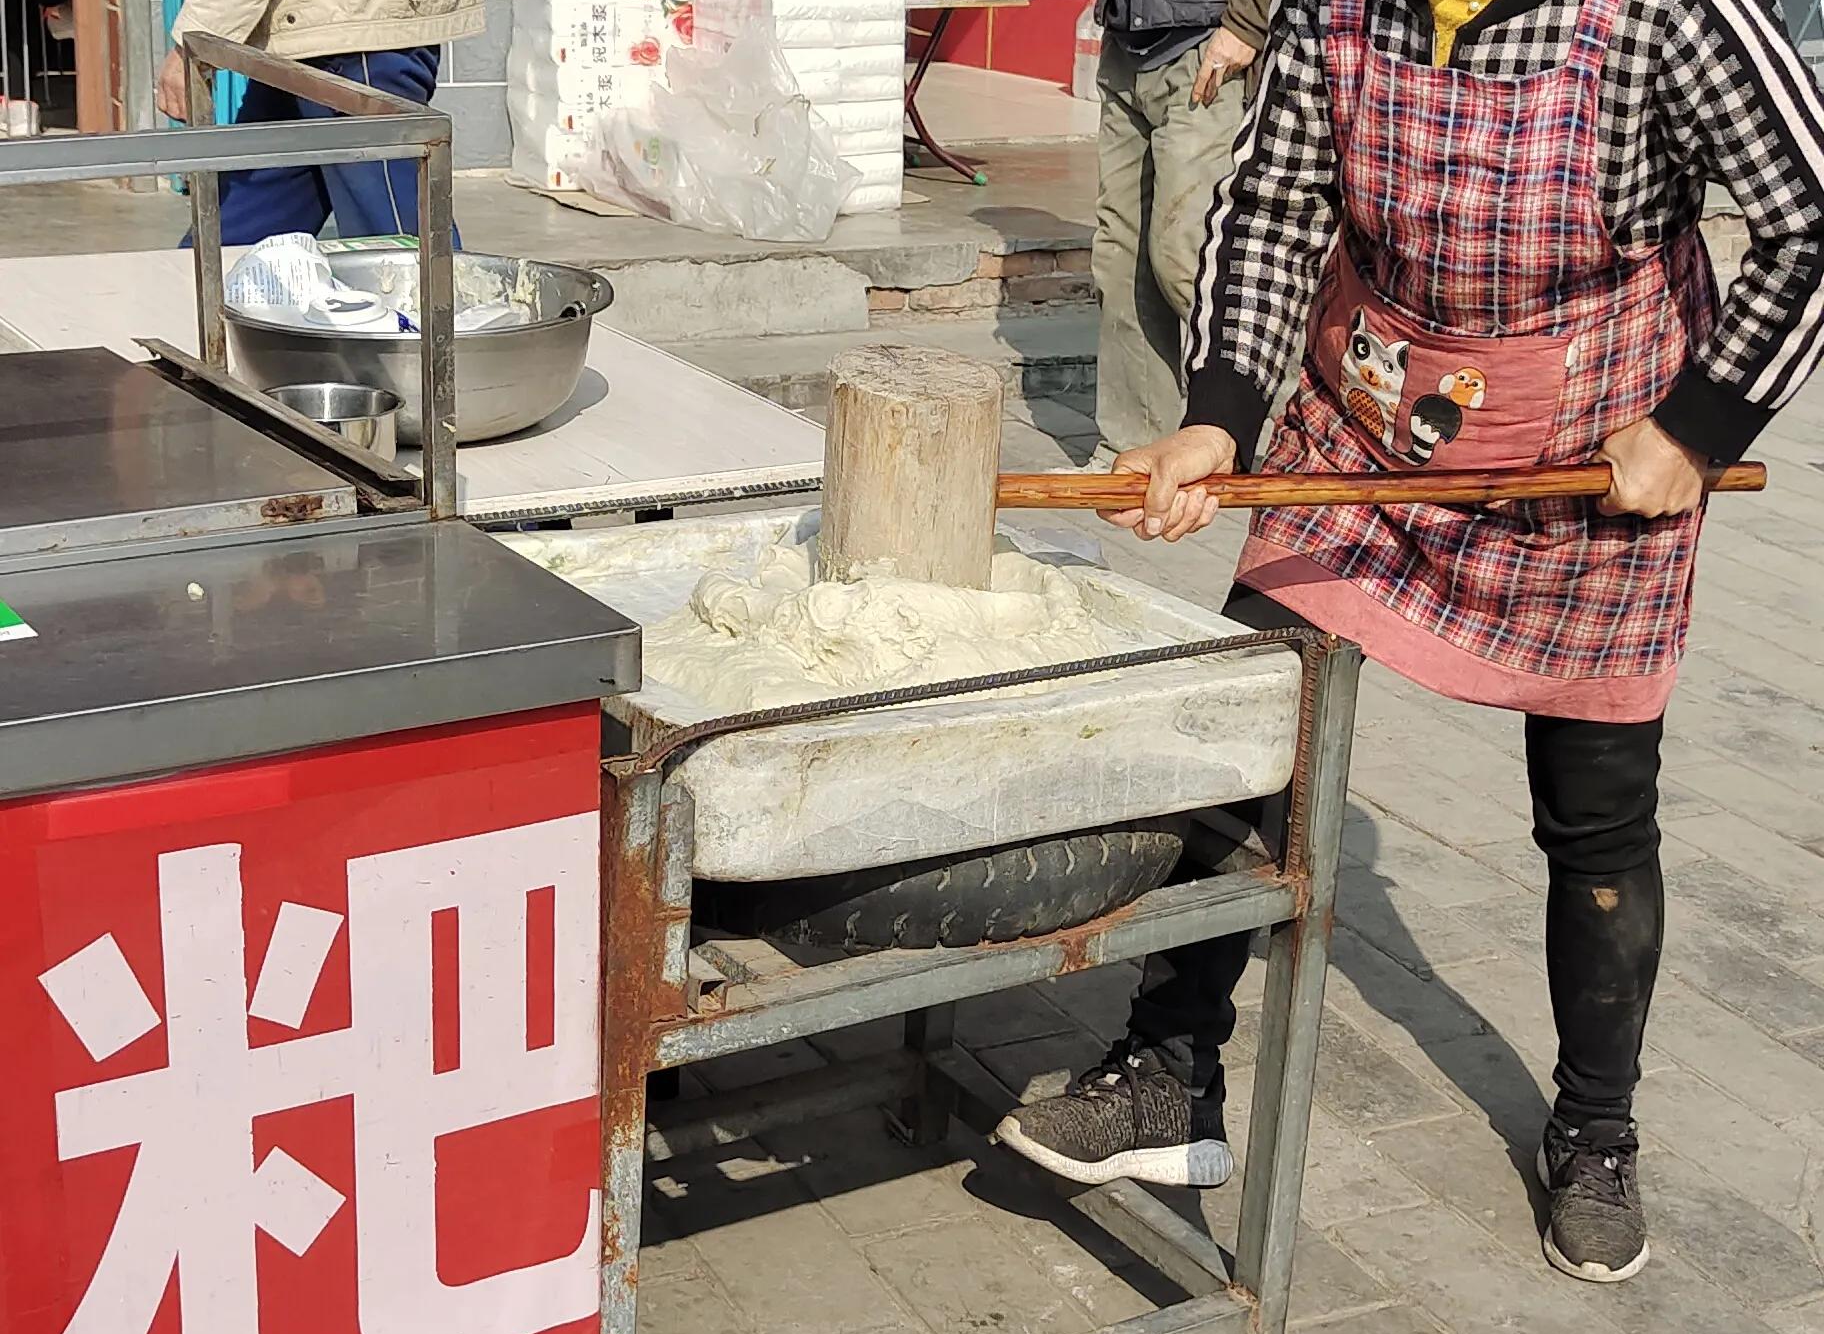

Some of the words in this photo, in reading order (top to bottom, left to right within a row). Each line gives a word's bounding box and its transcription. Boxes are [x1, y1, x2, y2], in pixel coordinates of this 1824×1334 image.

[591, 3, 608, 64] 纯木浆
[597, 73, 613, 110] 木浆
